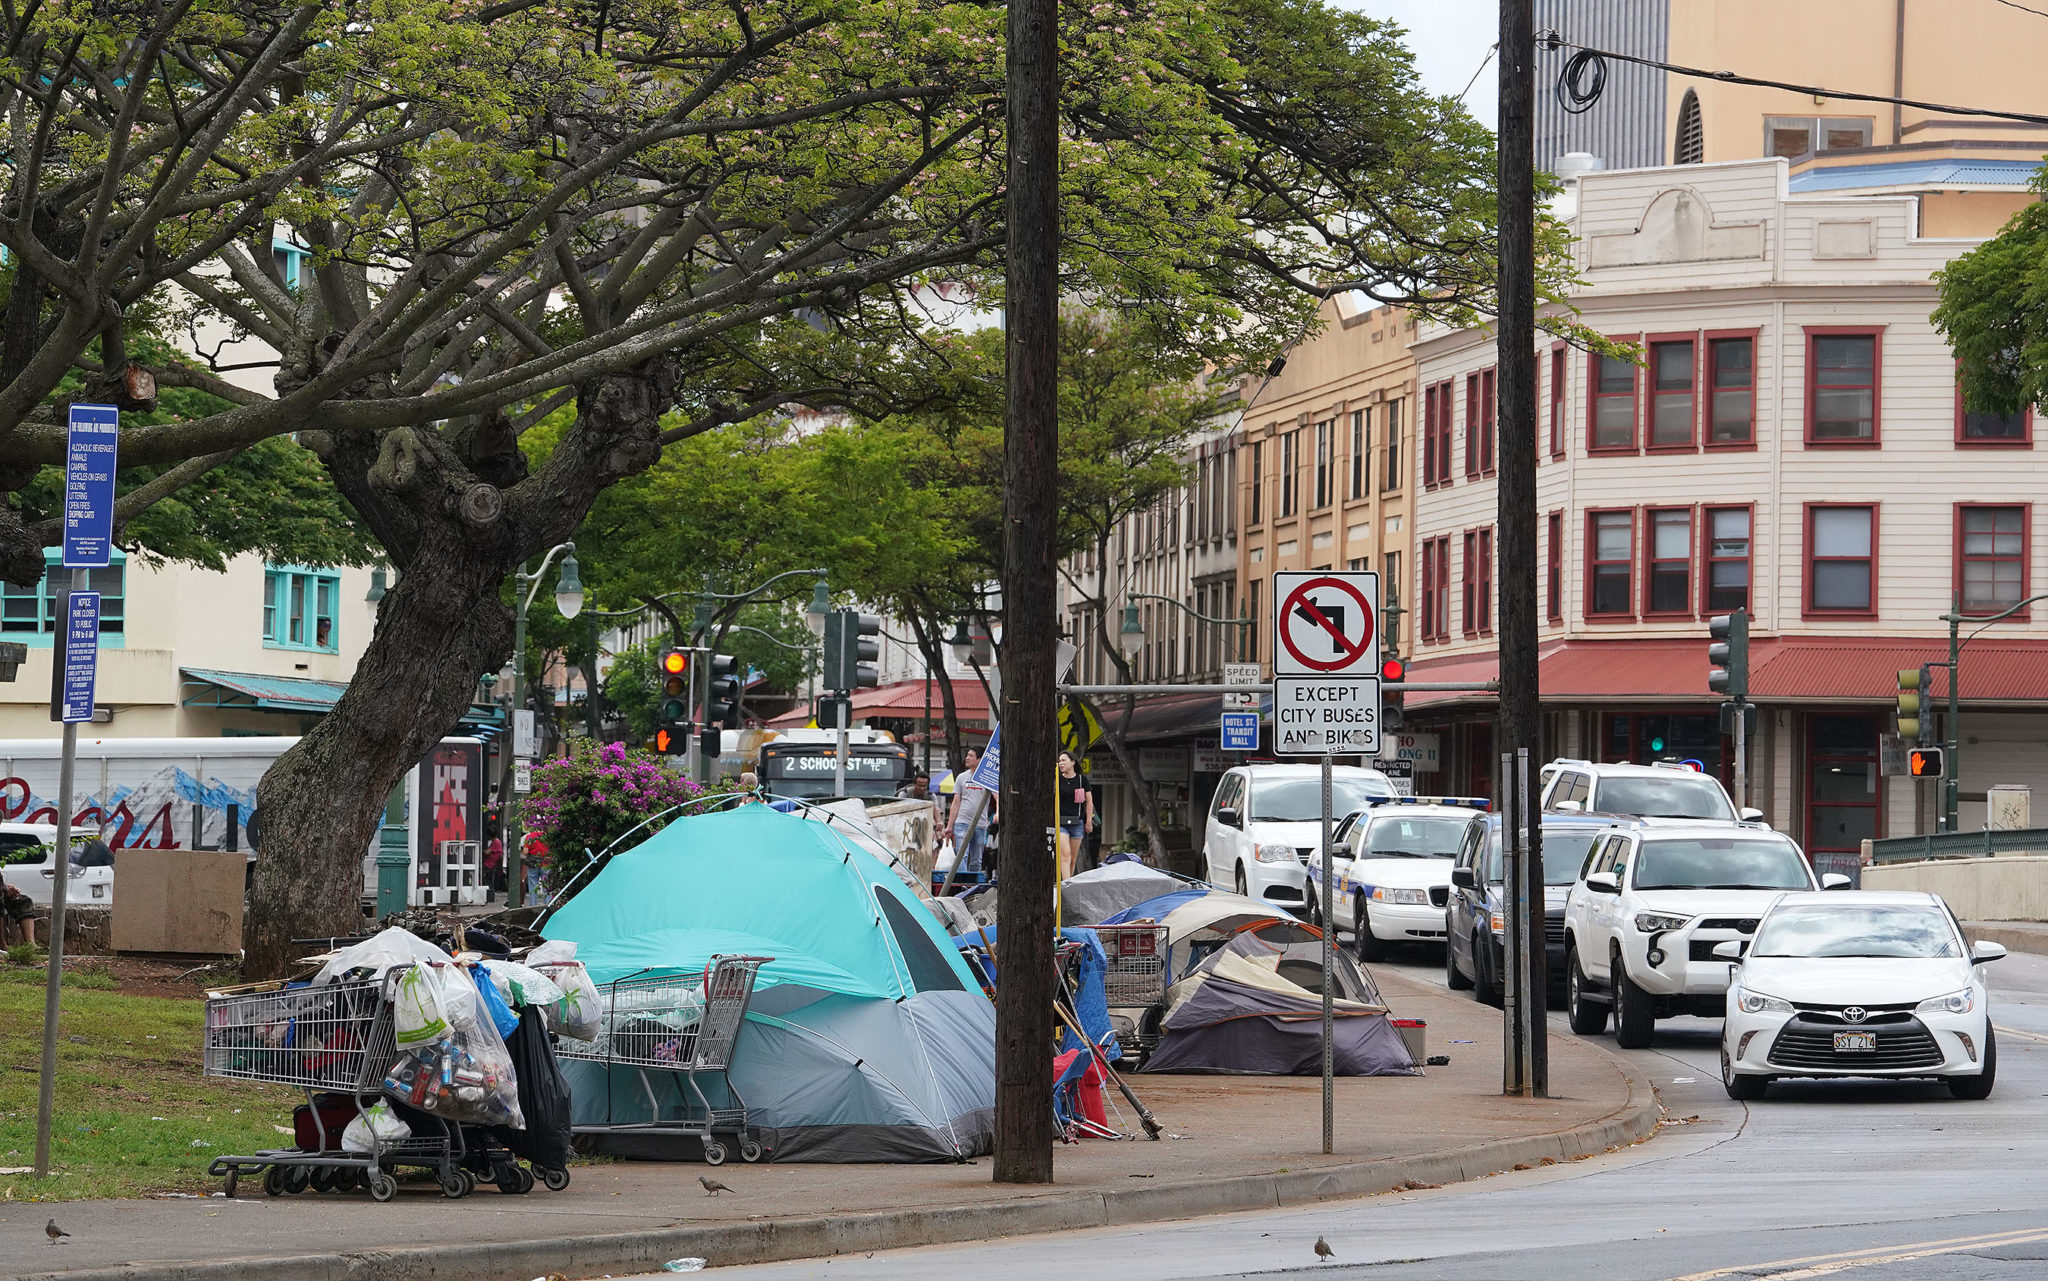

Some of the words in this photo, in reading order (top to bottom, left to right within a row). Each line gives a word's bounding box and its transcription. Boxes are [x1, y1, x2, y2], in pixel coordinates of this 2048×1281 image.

[71, 443, 92, 452] ALCOHOLIC
[93, 444, 114, 453] BEVERAGES
[70, 453, 87, 461] ANIMALS
[70, 462, 87, 471] CAMPING
[70, 472, 88, 481] VEHICLES
[88, 473, 94, 481] ON
[69, 482, 86, 490] GOLFING
[69, 492, 87, 500] LITTERING
[68, 501, 79, 509] OPEN
[82, 609, 96, 617] CLOSED
[1226, 668, 1258, 676] SPEED
[1295, 686, 1359, 702] EXCEPT
[1280, 708, 1317, 723] CITY
[1323, 708, 1375, 723] BUSES
[1225, 718, 1243, 726] HOTEL
[1245, 718, 1256, 727] ST.
[1226, 727, 1254, 736] TRANSIT
[1231, 737, 1249, 745] MALL
[1326, 729, 1373, 745] BIKS
[786, 757, 794, 770] 2
[799, 757, 838, 771] SCHOO
[846, 758, 862, 770] ST
[1374, 762, 1411, 770] RESTRICTED
[1393, 780, 1410, 788] USES
[1835, 1036, 1852, 1048] SSY
